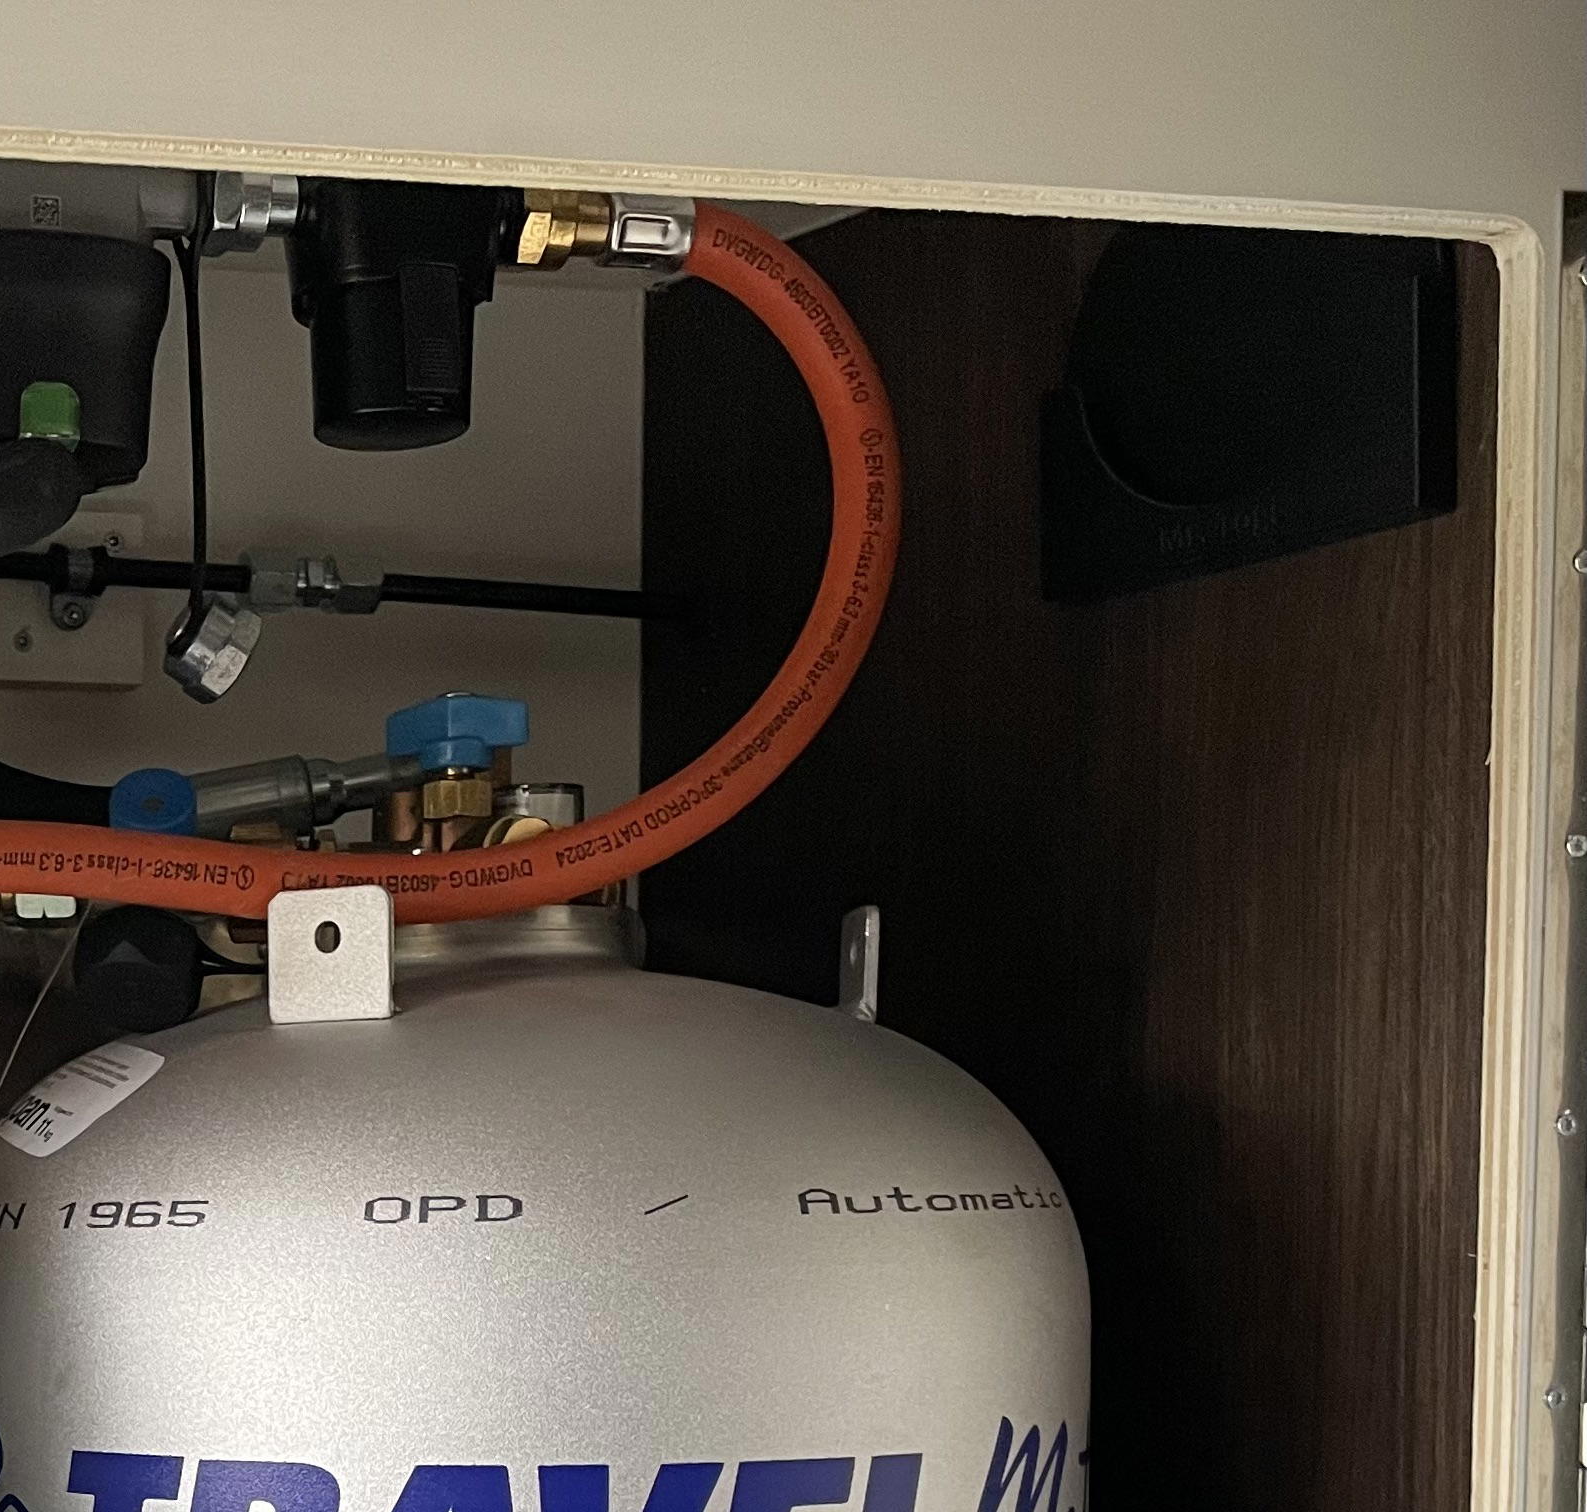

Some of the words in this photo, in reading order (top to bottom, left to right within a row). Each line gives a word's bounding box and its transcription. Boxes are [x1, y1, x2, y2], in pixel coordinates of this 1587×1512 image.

[57, 1199, 209, 1230] 1965
[363, 1193, 525, 1225] OPD
[797, 1184, 1063, 1216] Automatic
